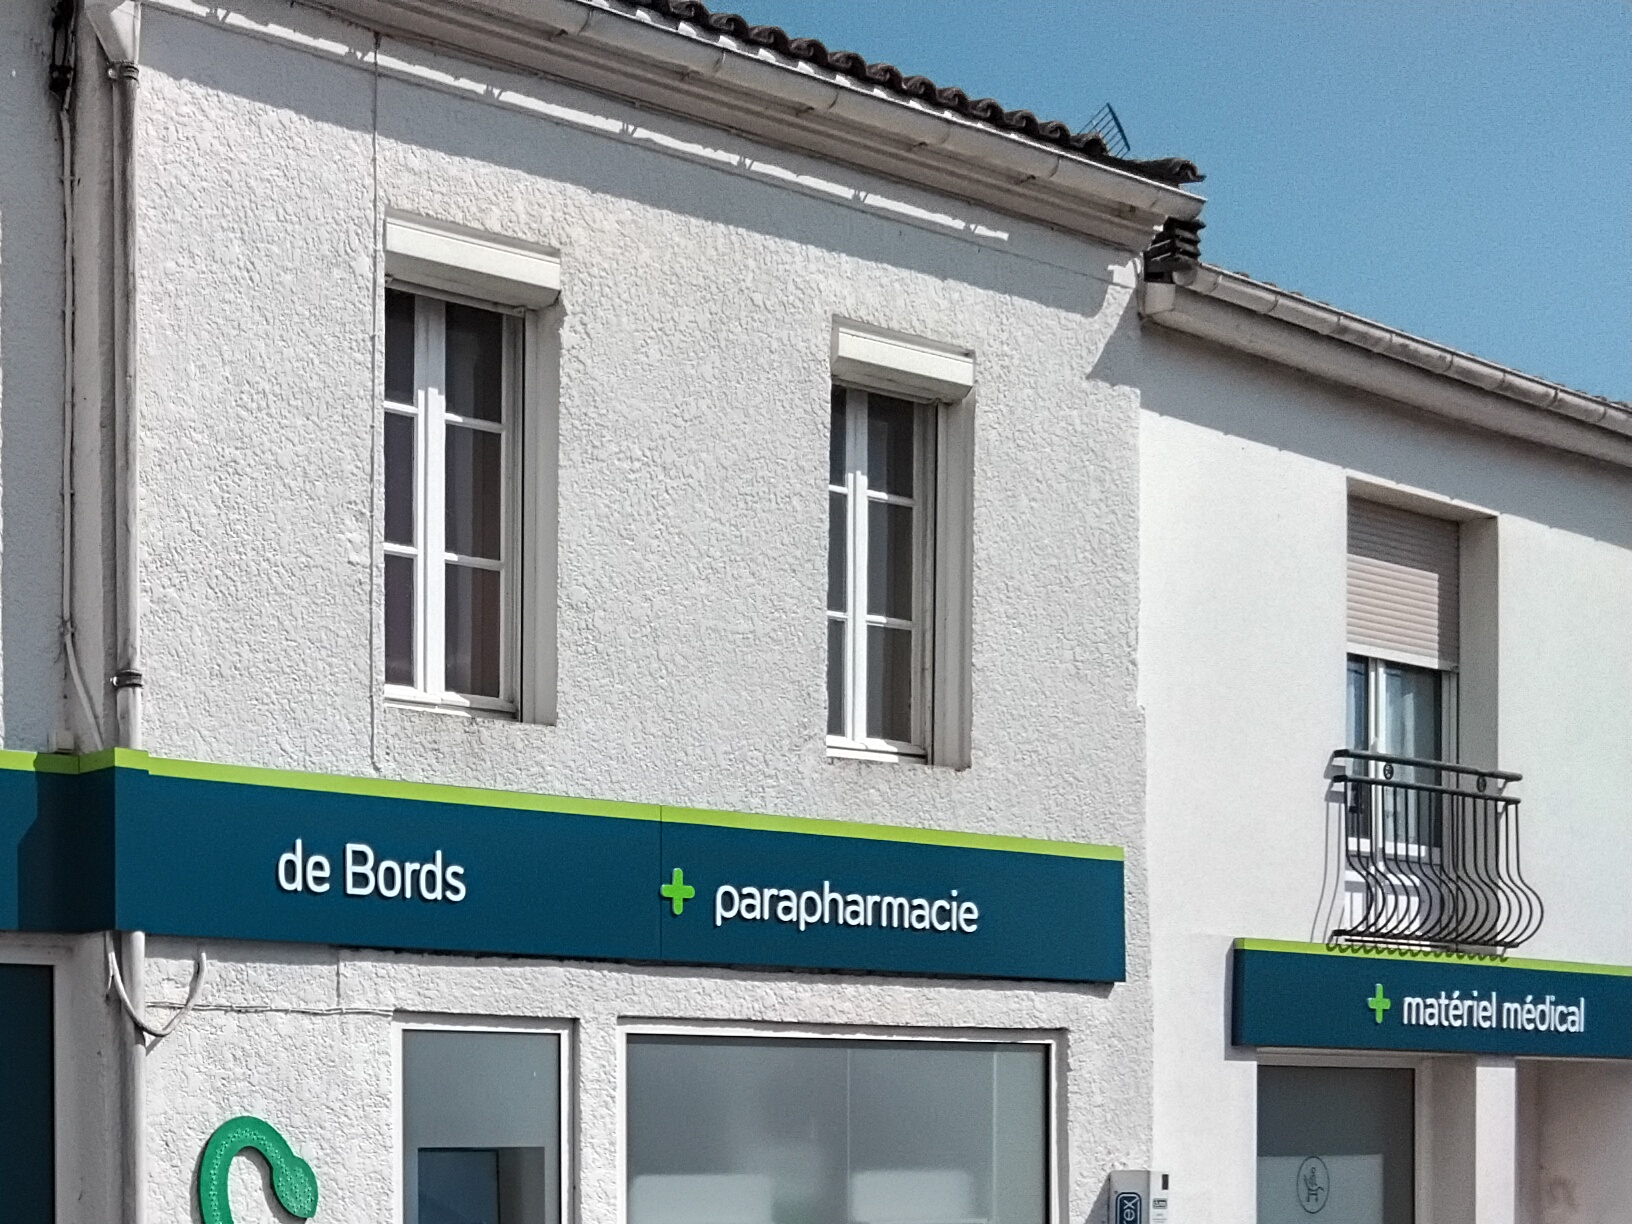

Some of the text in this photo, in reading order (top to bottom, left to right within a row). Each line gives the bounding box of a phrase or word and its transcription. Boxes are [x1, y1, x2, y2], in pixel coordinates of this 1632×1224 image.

[277, 838, 468, 904] de Bords
[715, 877, 981, 934] parapharmacie
[1402, 990, 1587, 1033] matériel médical
